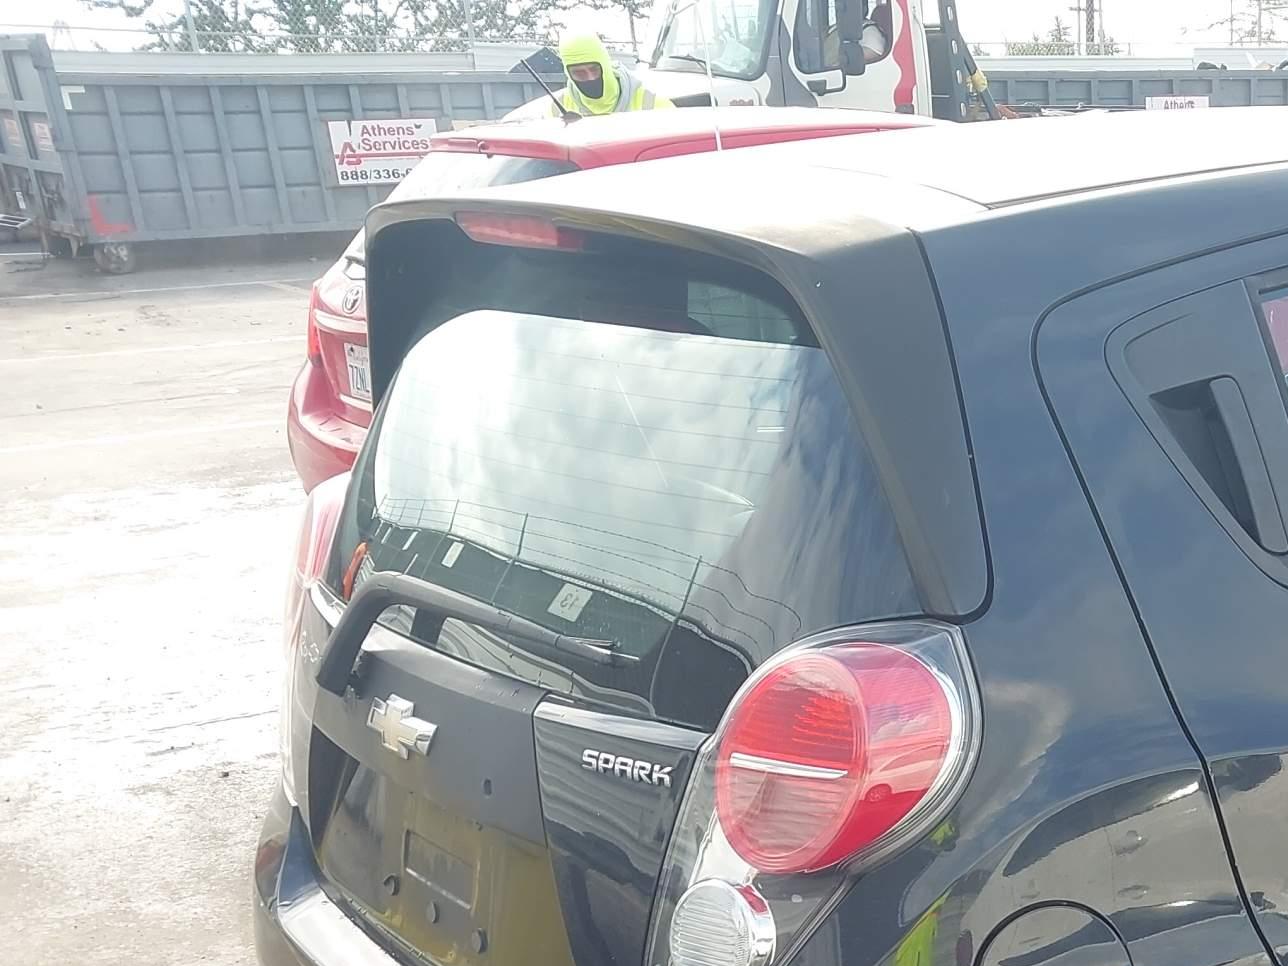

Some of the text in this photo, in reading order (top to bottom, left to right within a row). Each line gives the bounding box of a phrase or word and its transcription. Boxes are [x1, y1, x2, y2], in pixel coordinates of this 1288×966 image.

[360, 124, 415, 137] Athens
[361, 137, 430, 152] Services
[582, 749, 673, 787] SPARK
